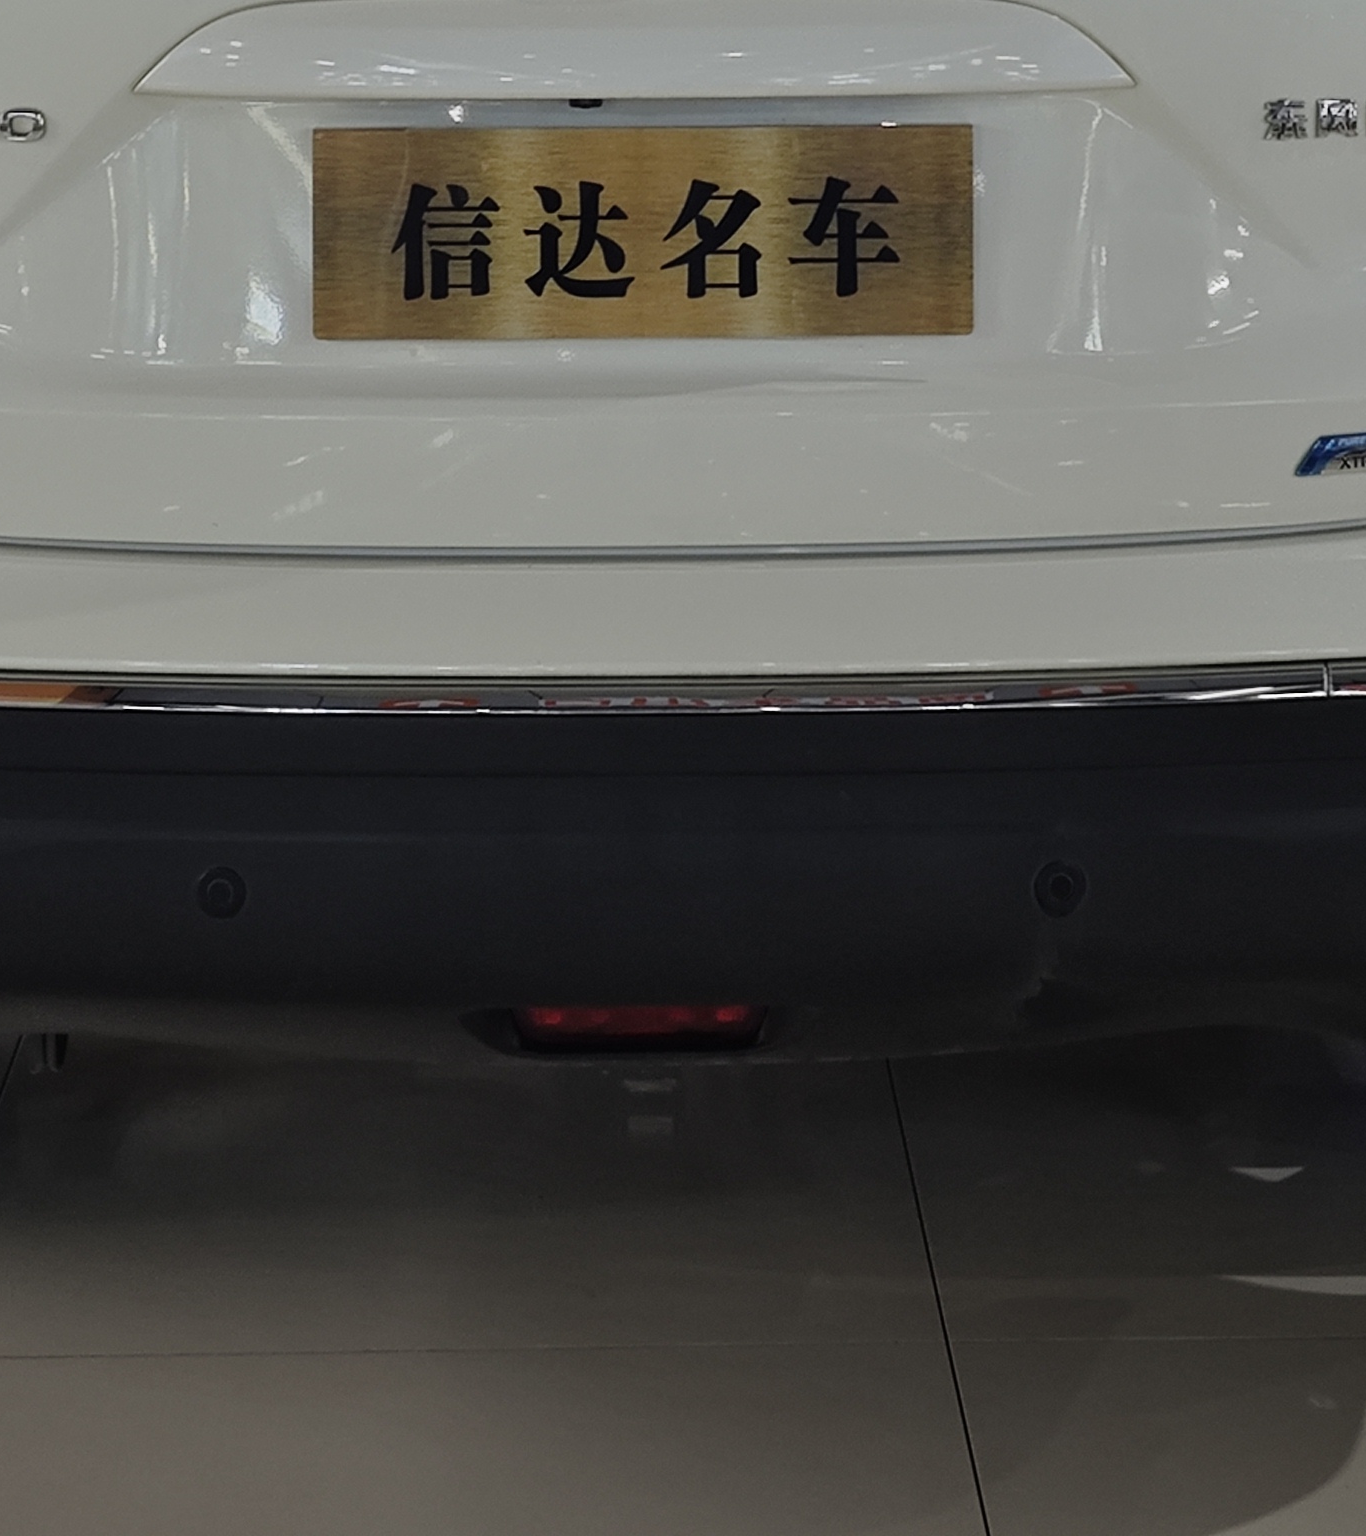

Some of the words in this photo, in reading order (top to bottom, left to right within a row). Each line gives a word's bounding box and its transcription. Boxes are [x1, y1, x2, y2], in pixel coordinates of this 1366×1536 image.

[390, 175, 902, 301] 信达名车
[1338, 434, 1366, 447] PURE
